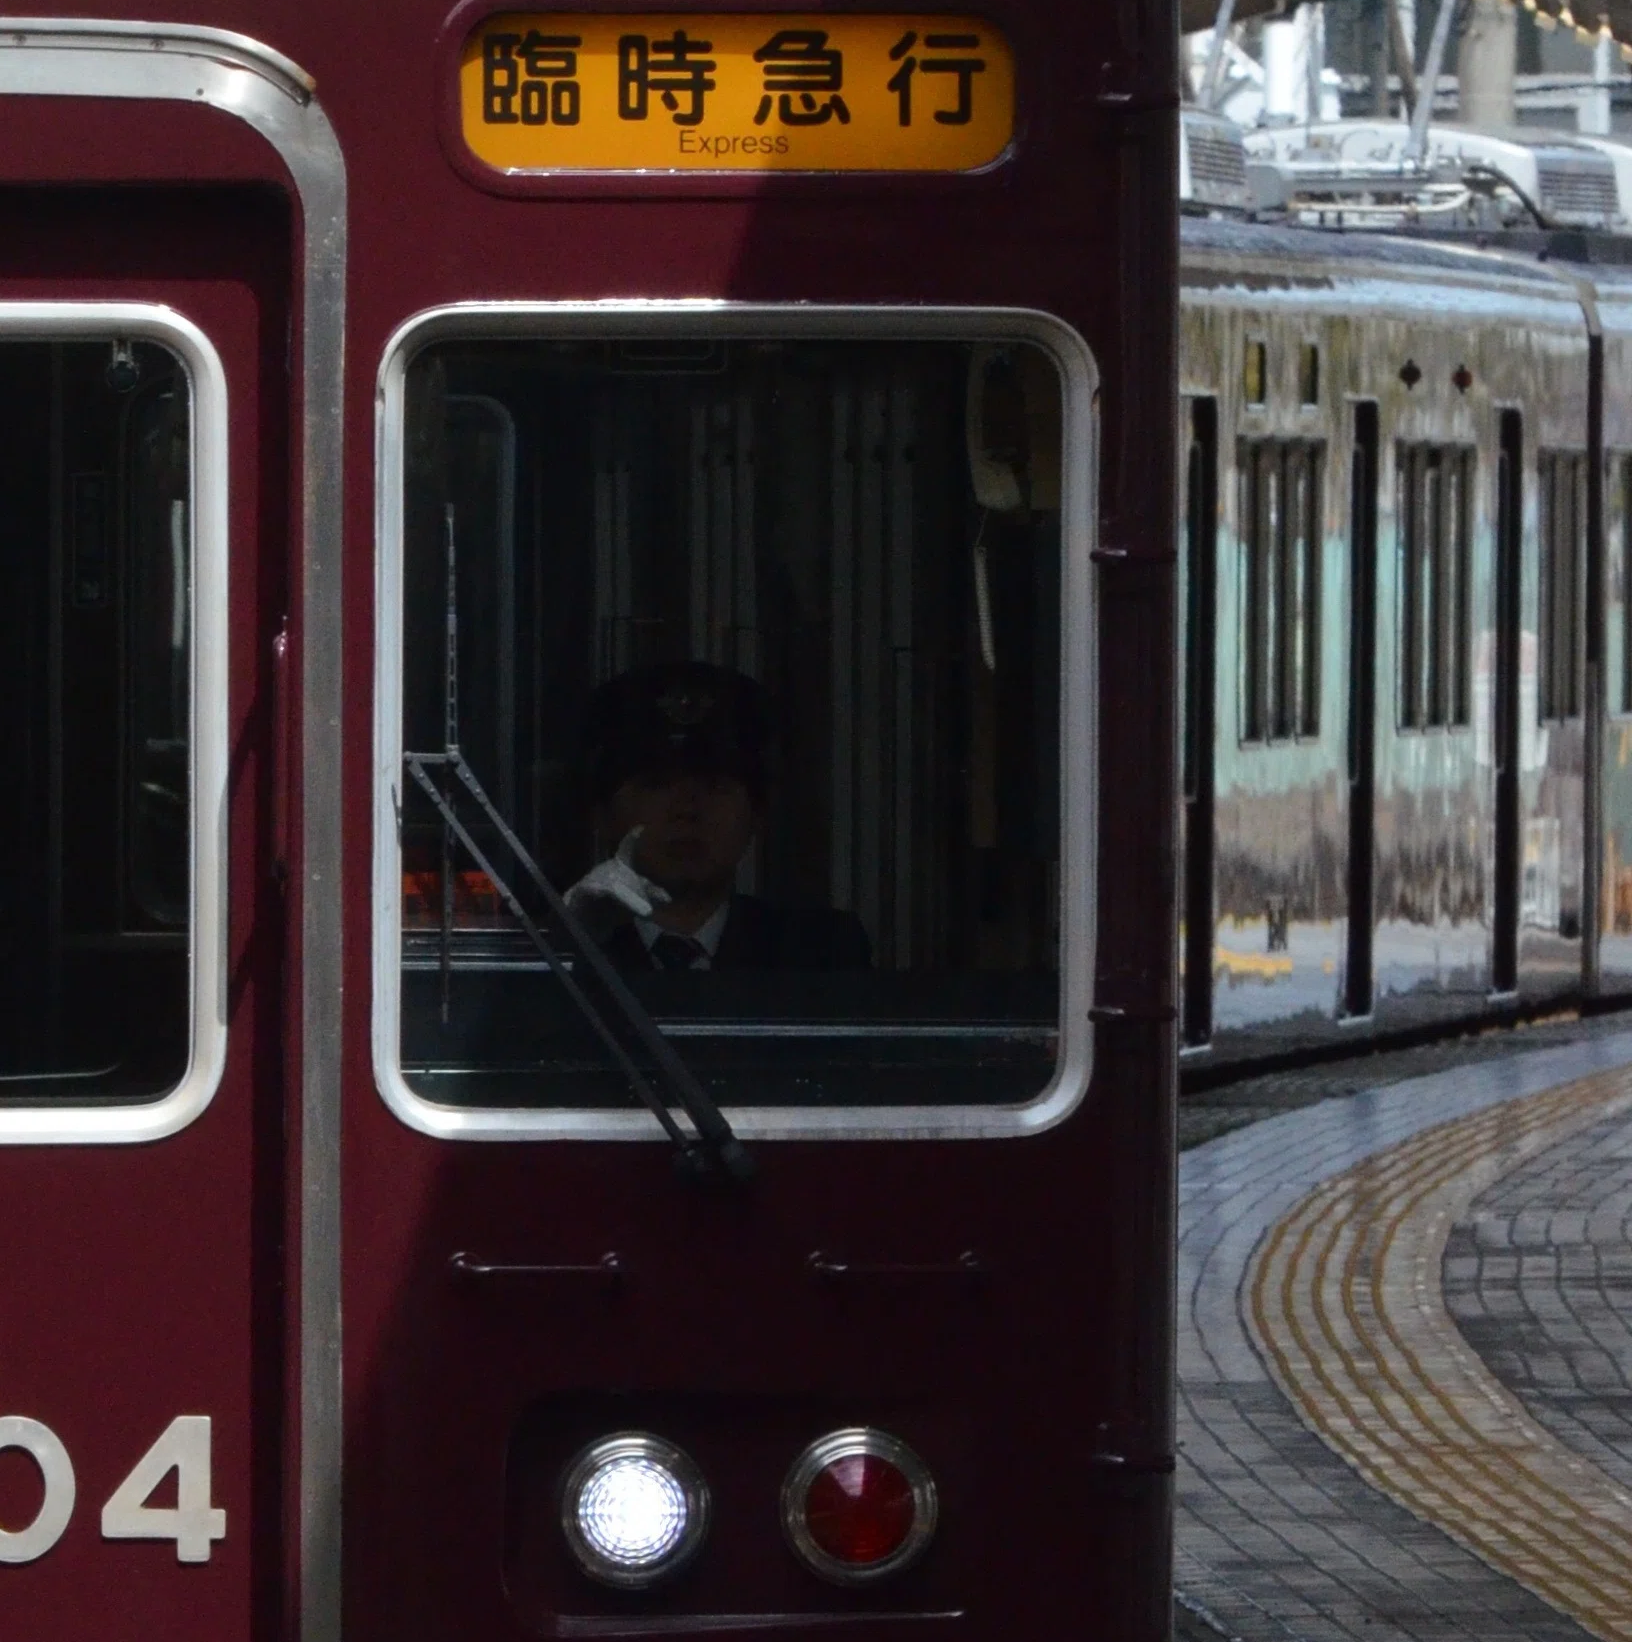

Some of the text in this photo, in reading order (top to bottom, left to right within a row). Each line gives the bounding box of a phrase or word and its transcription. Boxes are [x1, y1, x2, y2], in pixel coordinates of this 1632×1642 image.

[481, 29, 987, 128] 臨時急行
[678, 129, 790, 158] Express
